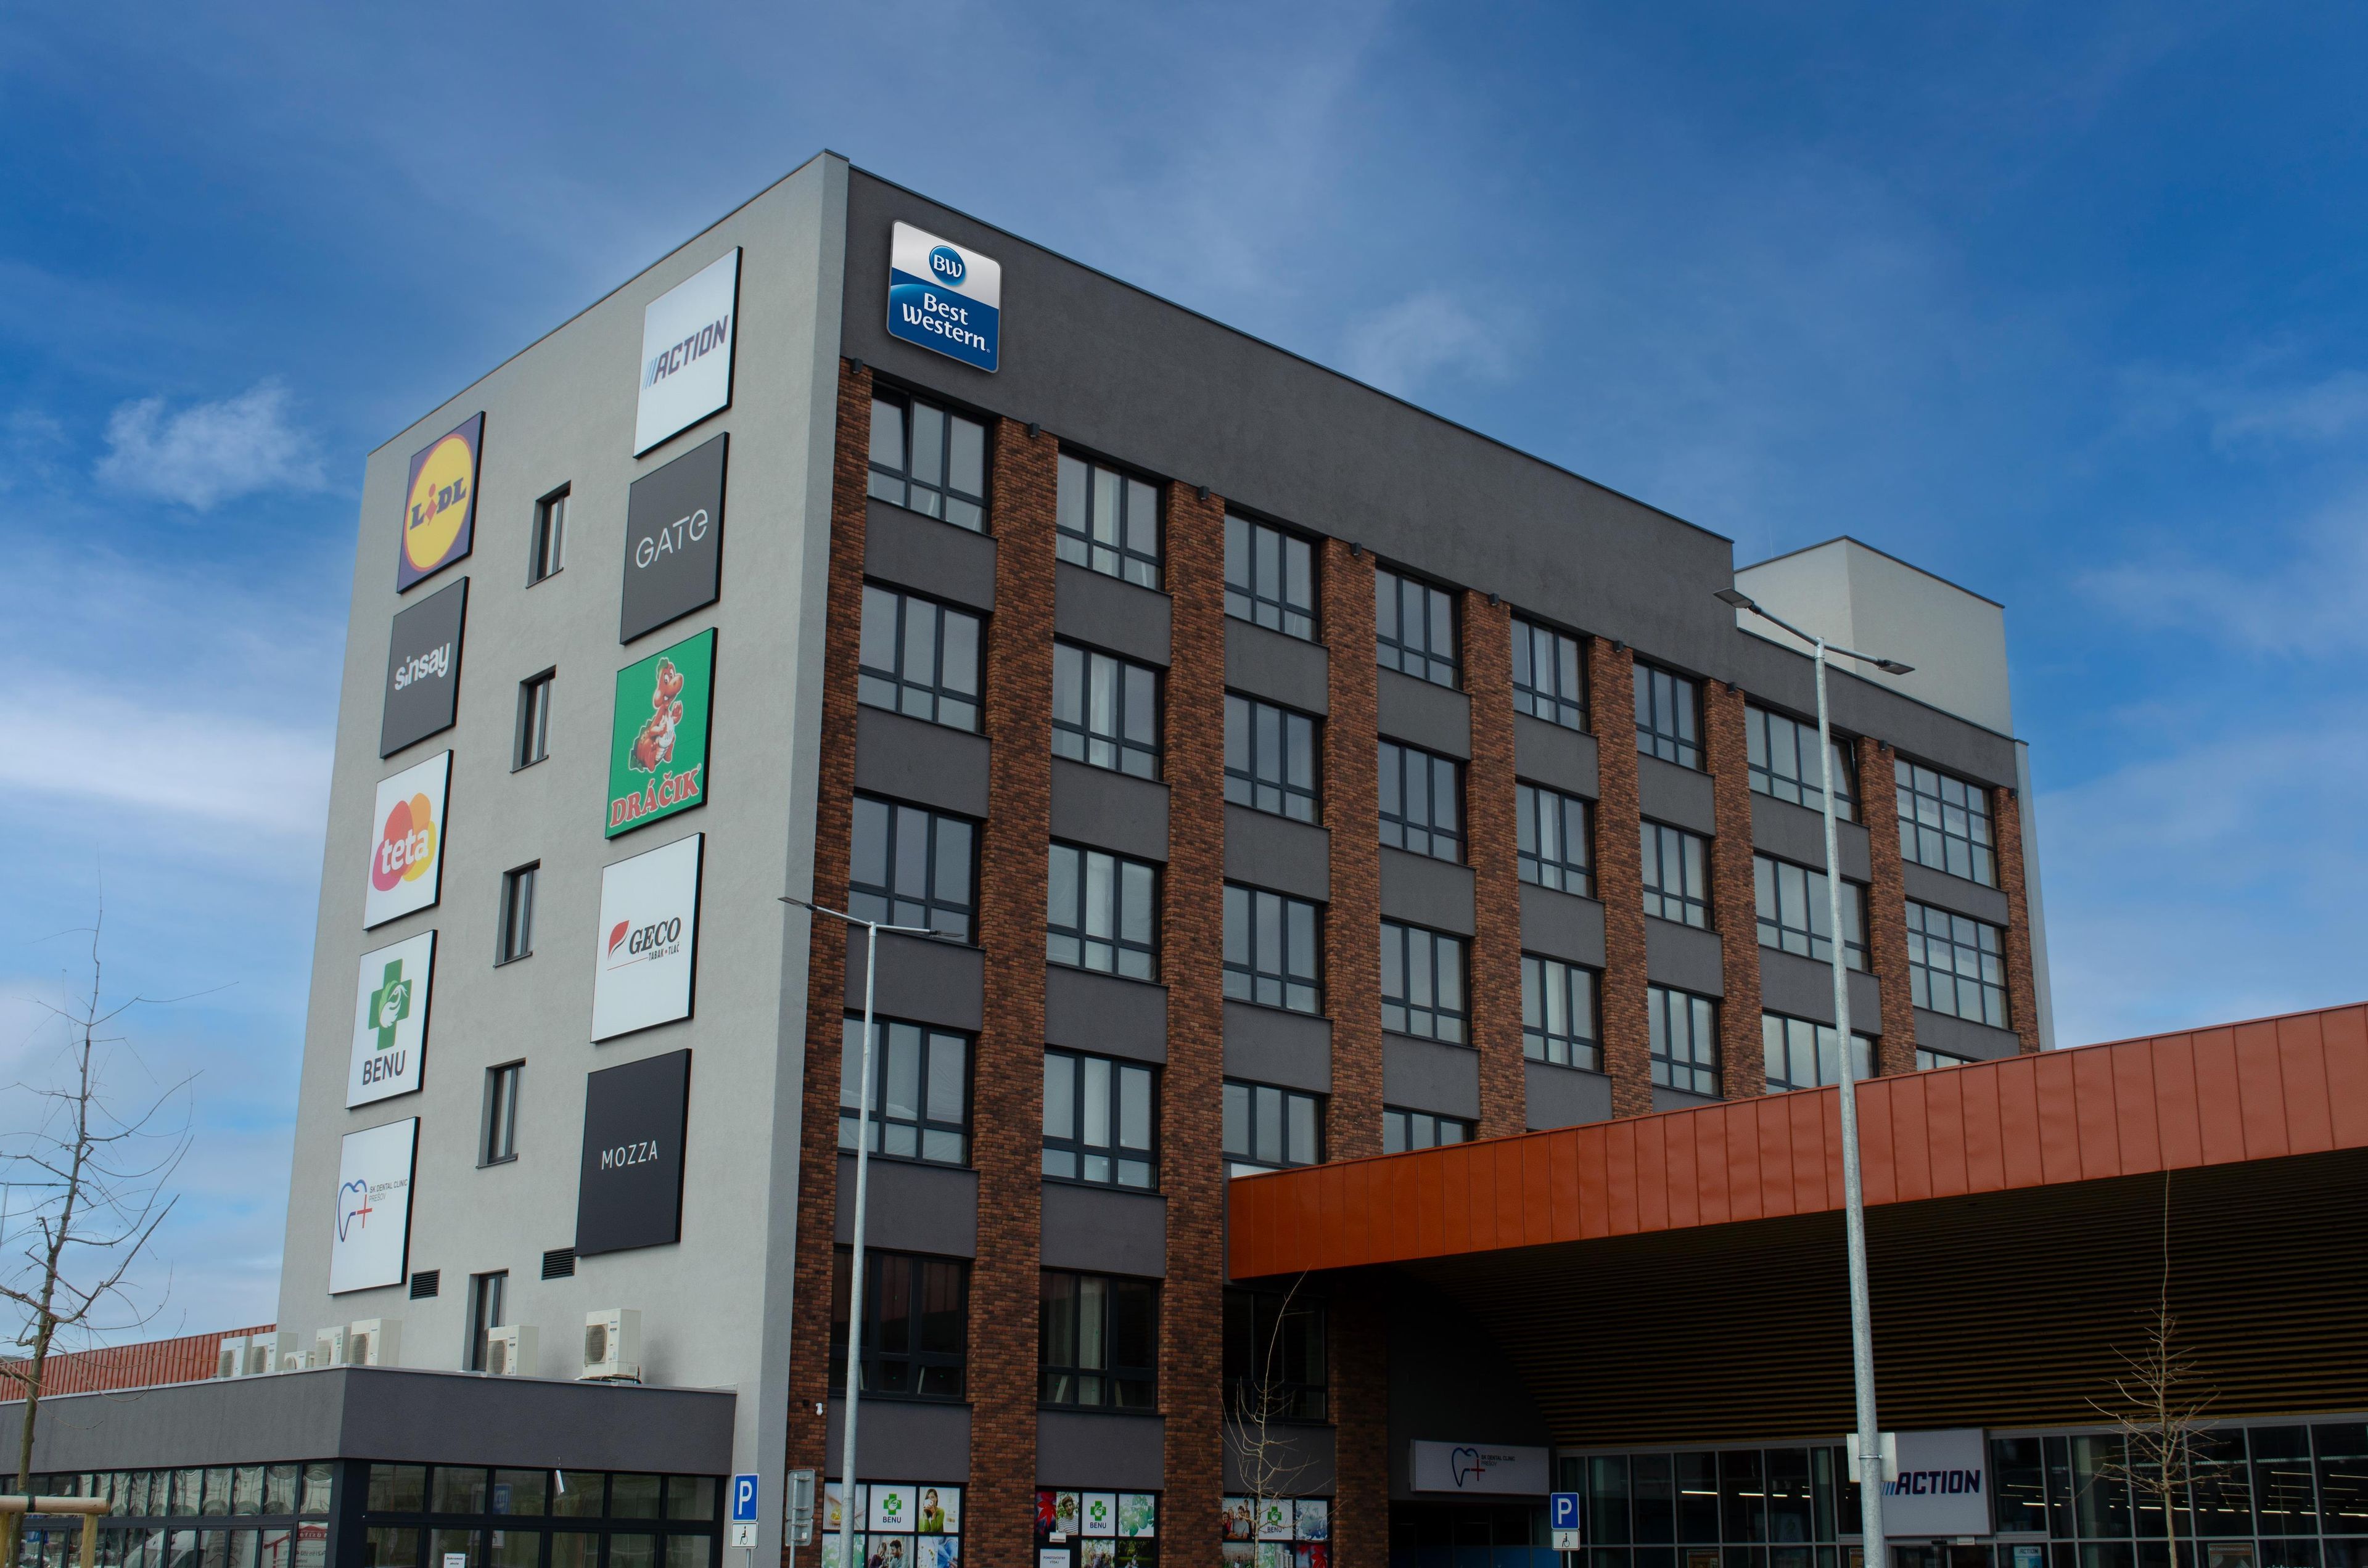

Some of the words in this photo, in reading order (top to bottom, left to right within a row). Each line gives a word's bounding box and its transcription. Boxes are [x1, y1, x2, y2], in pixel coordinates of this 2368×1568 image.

[933, 253, 963, 278] BW
[924, 292, 969, 326] Best
[902, 303, 986, 351] Western
[653, 314, 728, 384] ACTION
[395, 642, 451, 691] sinsay
[609, 768, 699, 827] DRÁČIK
[381, 828, 429, 875] teta
[629, 917, 681, 955] GECO
[649, 948, 664, 961] TABAK
[668, 941, 680, 955] TLAČ
[362, 1049, 406, 1086] BENU
[601, 1139, 658, 1170] MOZZA
[369, 1185, 376, 1194] SK
[376, 1182, 393, 1192] DENTAL
[393, 1178, 408, 1189] CLINIC
[738, 1480, 753, 1515] P
[1895, 1469, 1981, 1495] ACTION
[1558, 1498, 1572, 1524] P
